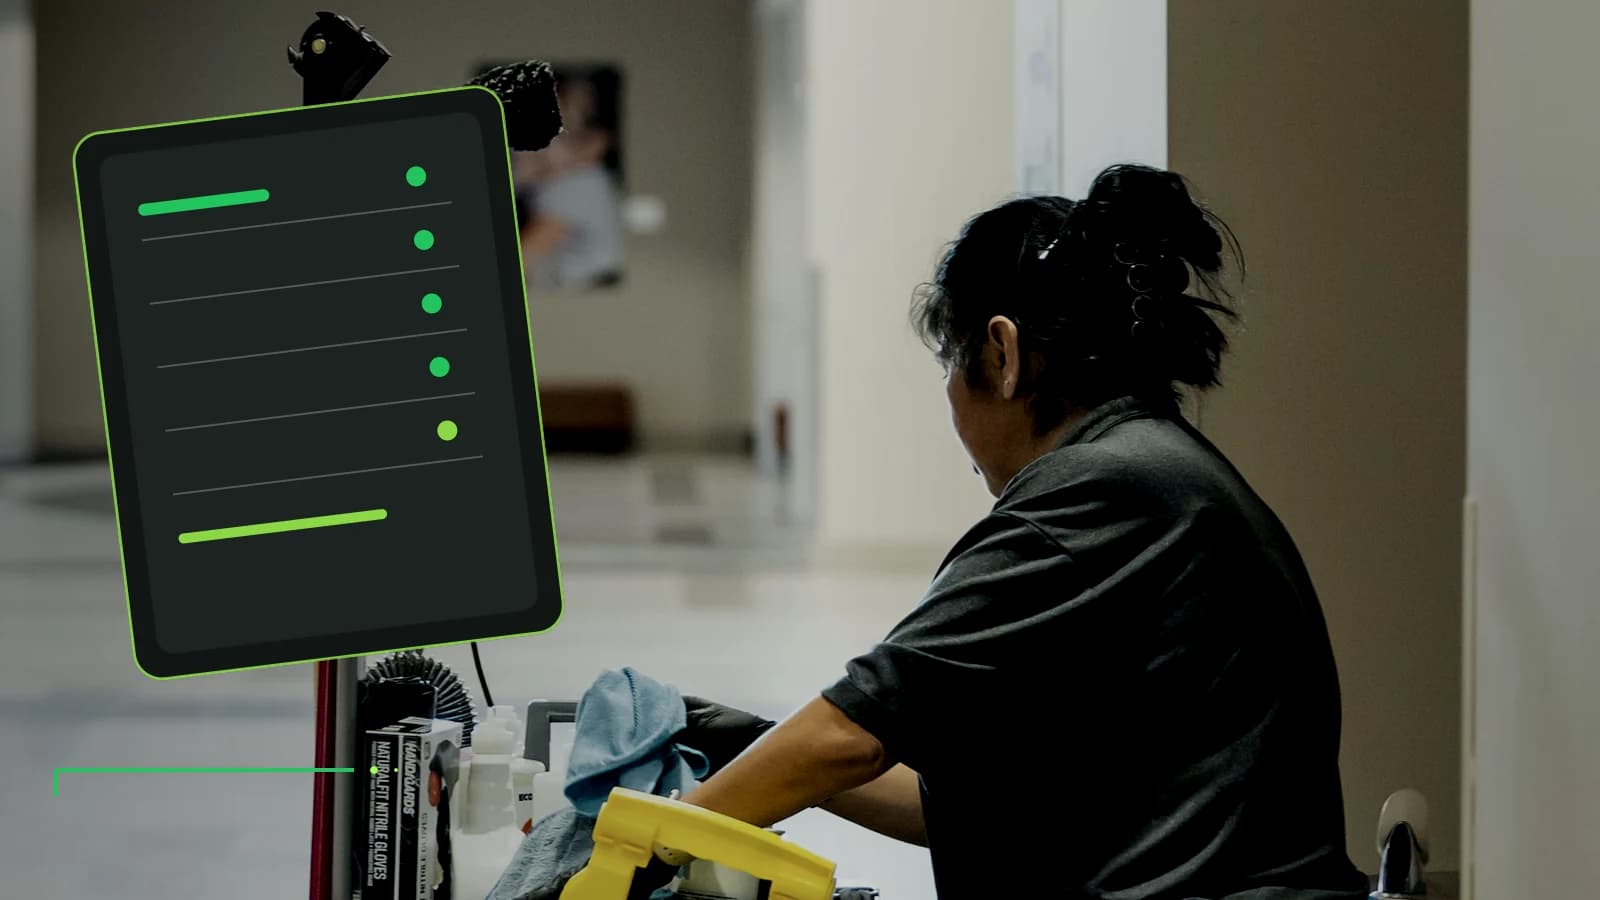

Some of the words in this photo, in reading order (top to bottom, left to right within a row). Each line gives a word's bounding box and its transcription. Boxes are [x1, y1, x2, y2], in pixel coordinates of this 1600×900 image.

[375, 741, 391, 801] NATURALFIT
[374, 802, 390, 840] NITRILE
[373, 841, 388, 880] GLOVES
